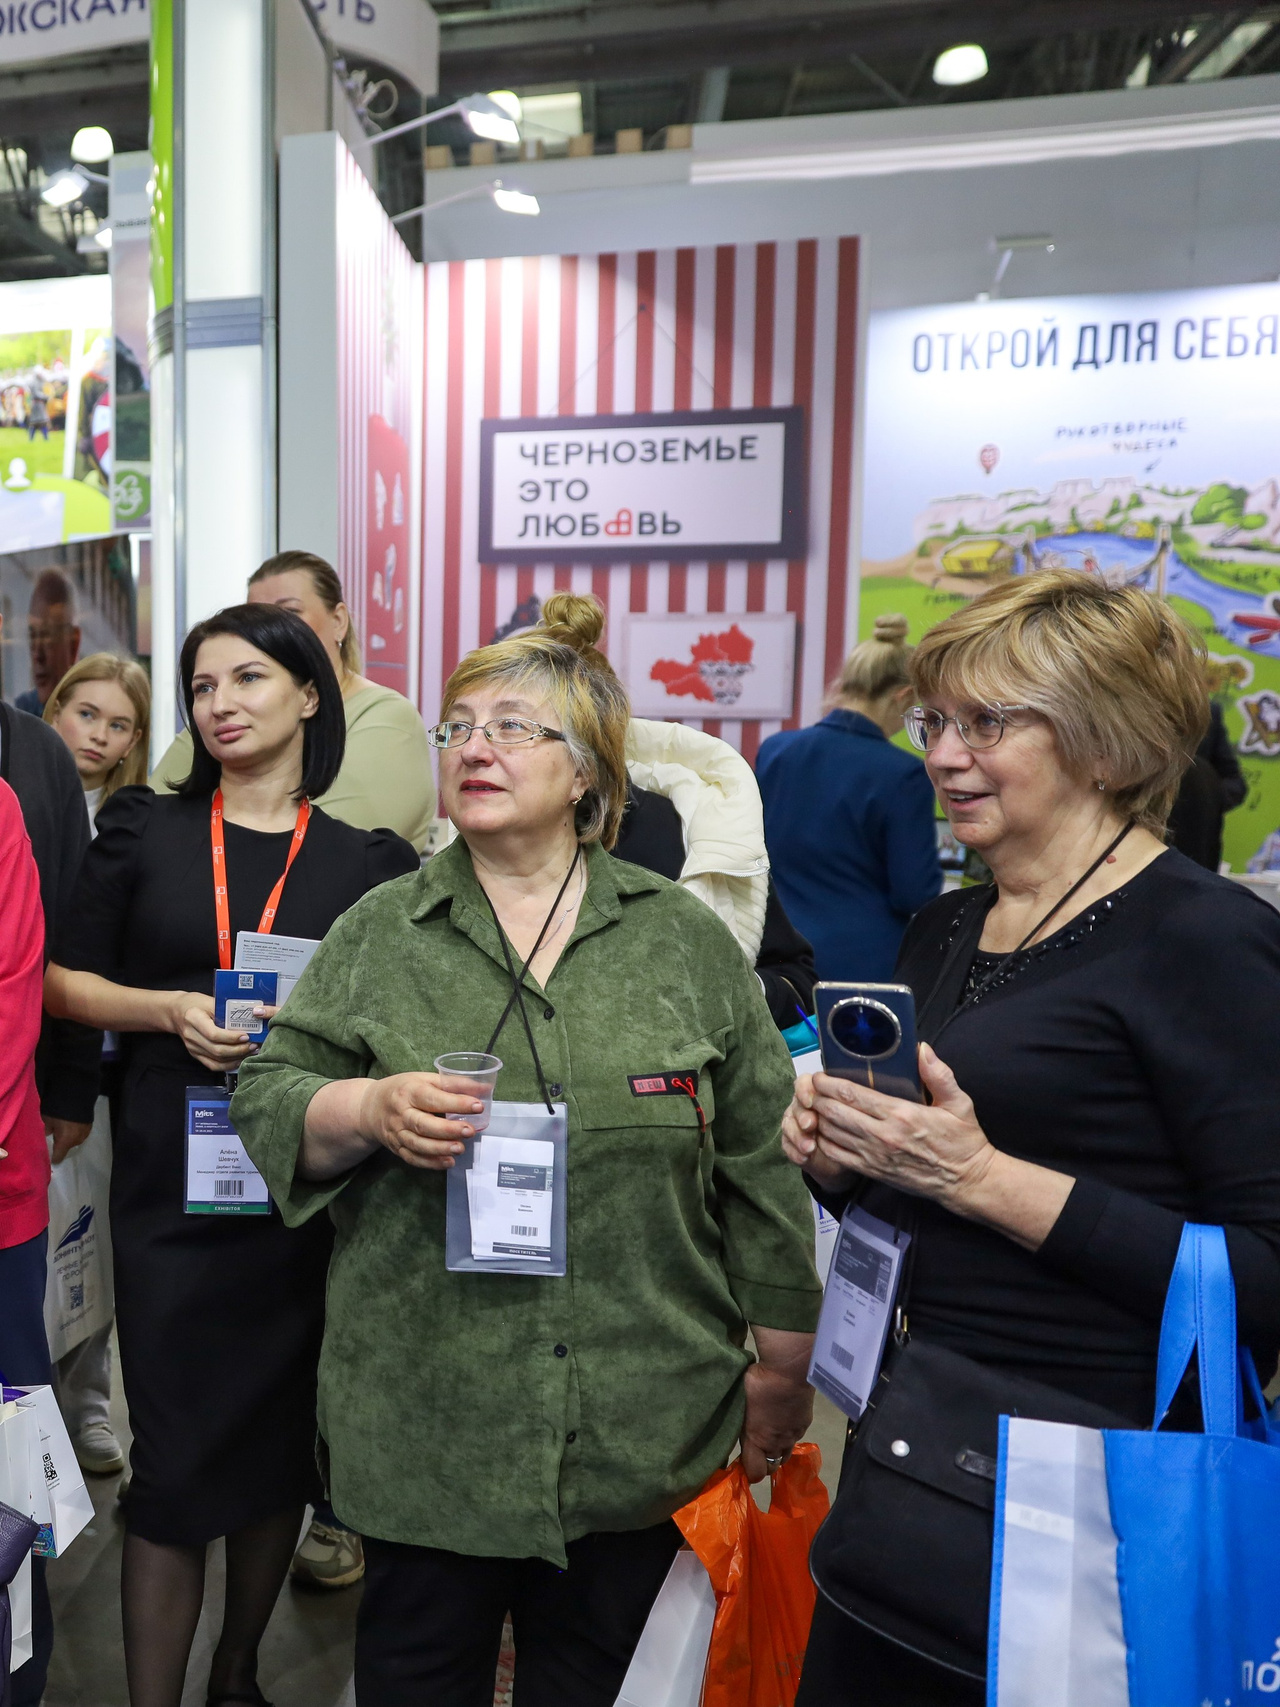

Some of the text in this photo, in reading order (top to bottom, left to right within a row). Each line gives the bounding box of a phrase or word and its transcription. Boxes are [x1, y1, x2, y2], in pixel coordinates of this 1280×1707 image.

[913, 314, 1280, 373] ОТКРОЙ ДЛЯ СЕБЯ
[519, 435, 759, 466] ЧЕРНОЗЕМЬЕ
[519, 478, 589, 503] ЭТО
